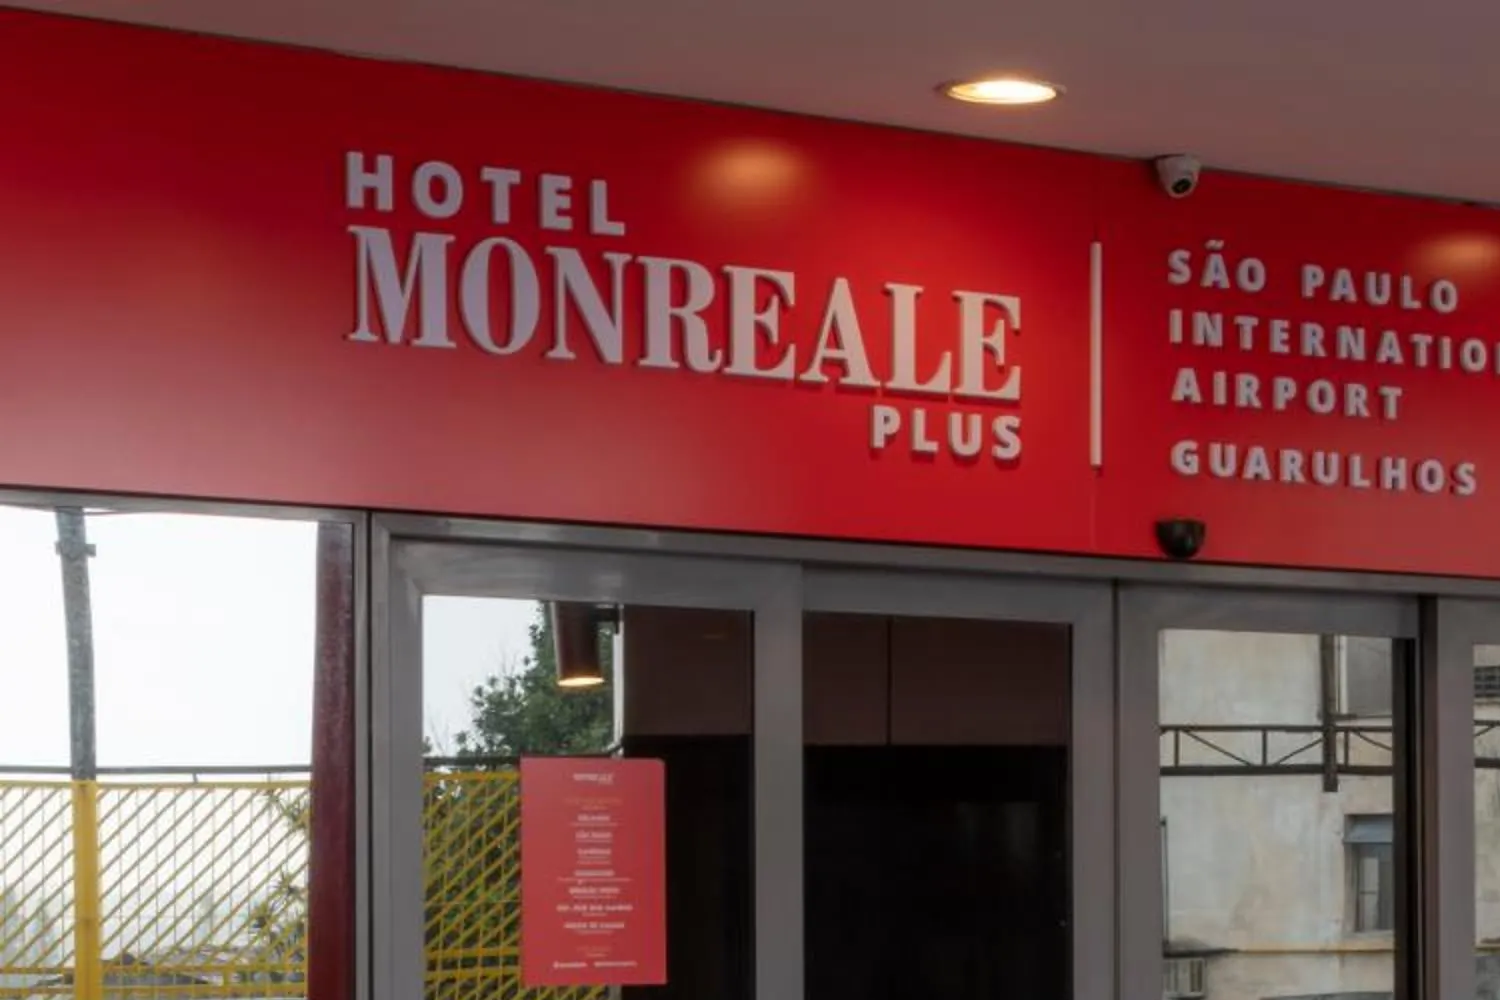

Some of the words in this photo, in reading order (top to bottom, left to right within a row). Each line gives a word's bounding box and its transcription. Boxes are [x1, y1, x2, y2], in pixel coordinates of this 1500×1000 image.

[346, 151, 626, 236] HOTEL
[1168, 240, 1267, 289] SÃO
[1301, 264, 1459, 314] PAULO
[347, 225, 1022, 402] MONREALE
[1172, 368, 1403, 420] AIRPORT
[871, 405, 1023, 461] PLUS
[1170, 440, 1477, 496] GUARULHOS
